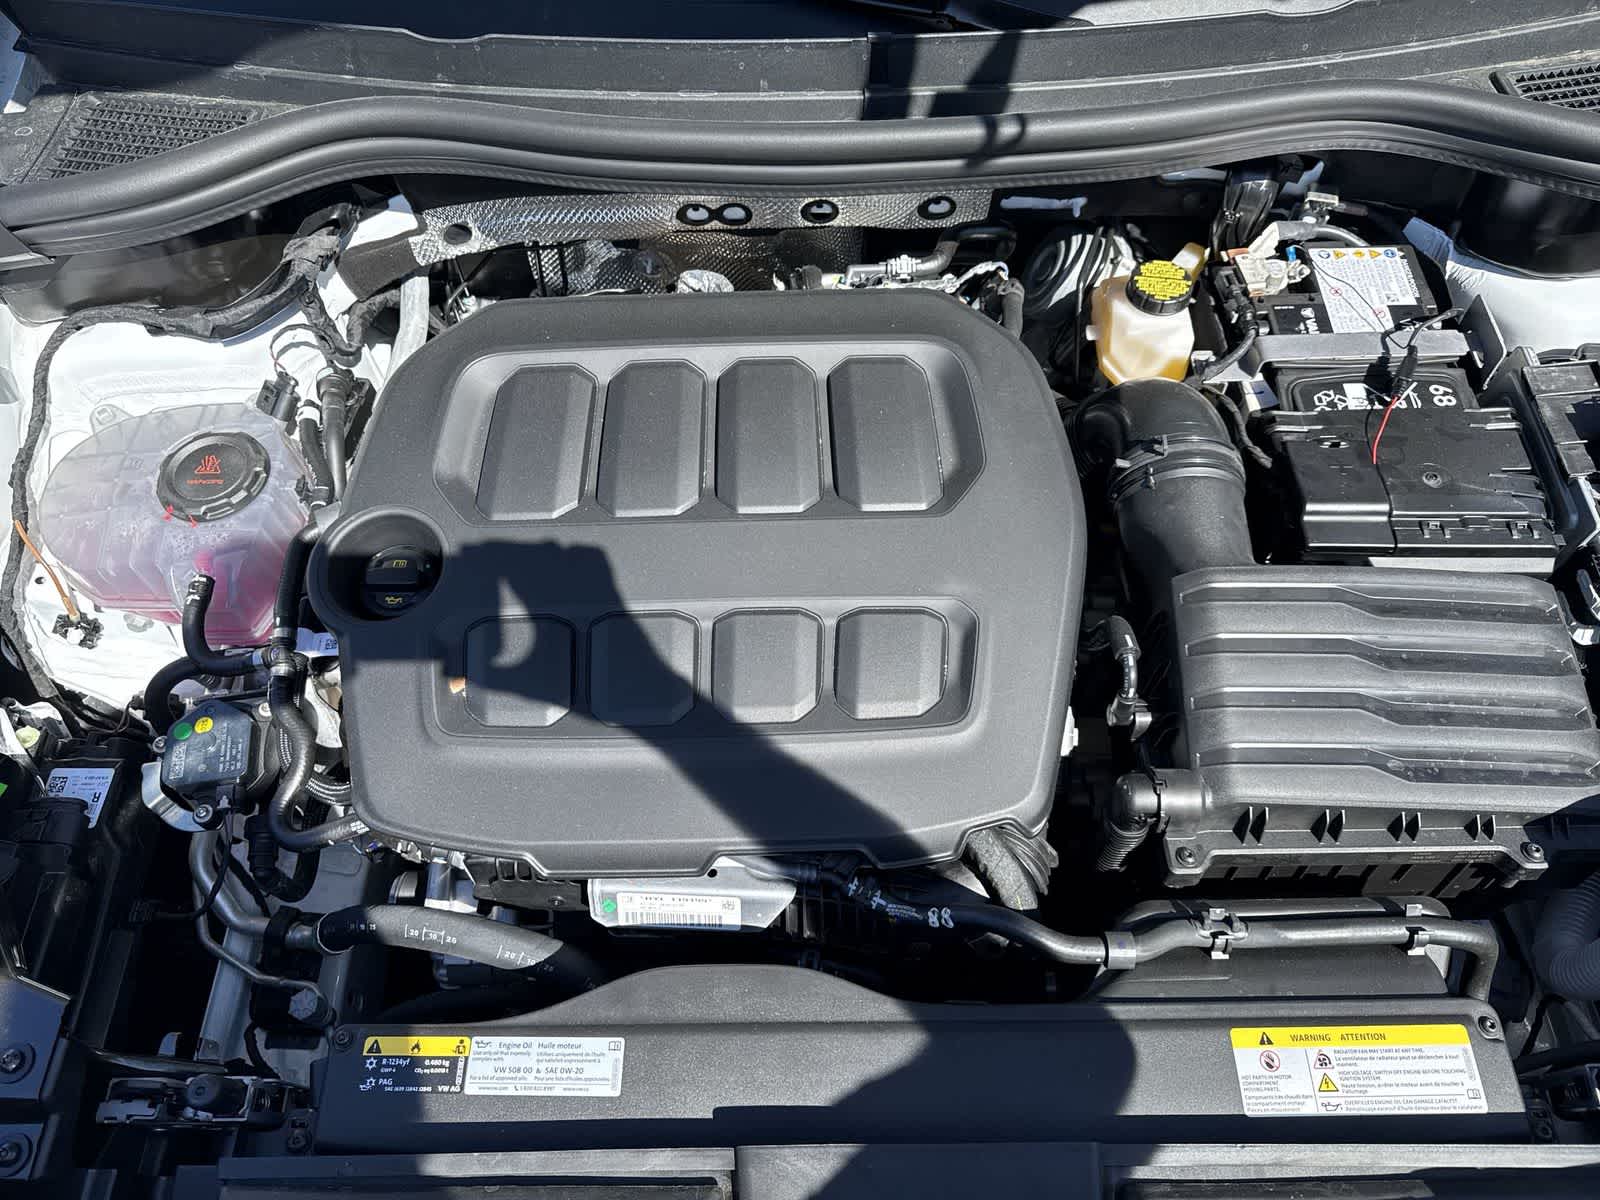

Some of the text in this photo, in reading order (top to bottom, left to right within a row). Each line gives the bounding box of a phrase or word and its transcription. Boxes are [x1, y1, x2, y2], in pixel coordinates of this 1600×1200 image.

[1429, 385, 1456, 406] 68
[1290, 1033, 1386, 1042] WARNING ATTENTION
[499, 1042, 521, 1050] Engine
[382, 1058, 410, 1067] R-1234yf
